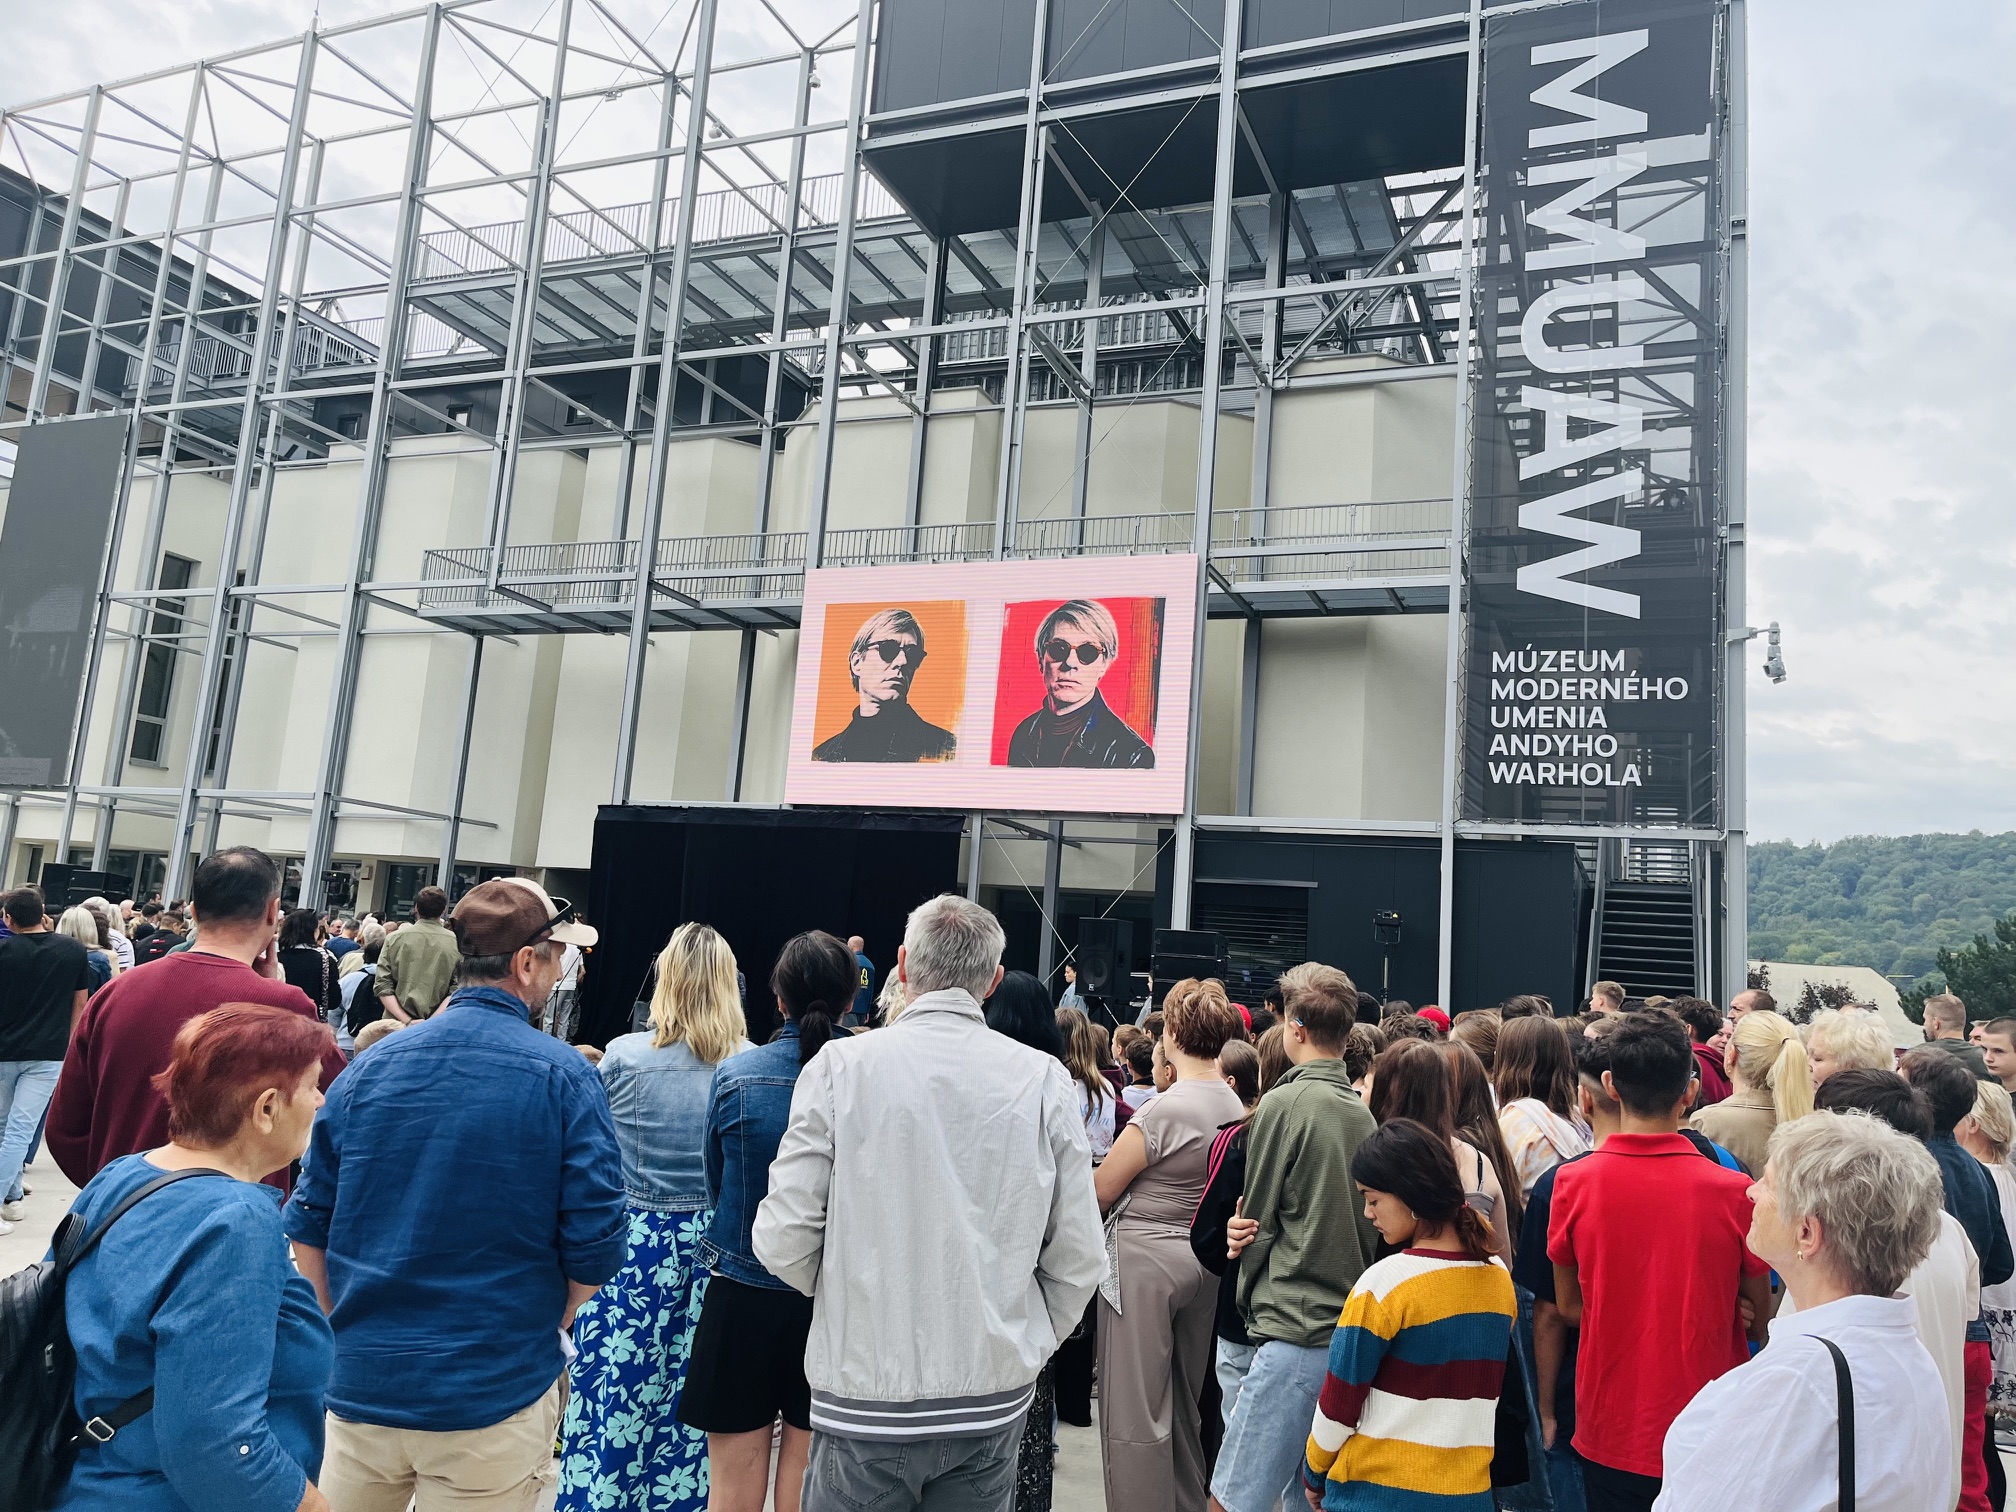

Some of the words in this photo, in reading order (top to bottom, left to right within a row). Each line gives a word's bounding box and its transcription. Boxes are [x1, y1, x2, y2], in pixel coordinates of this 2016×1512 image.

[1516, 28, 1649, 620] MMUAW
[1492, 643, 1625, 673] MÚZEUM
[1491, 670, 1689, 700] MODERNÉHO
[1490, 706, 1608, 729] UMENIA
[1489, 734, 1618, 758] ANDYHO
[1488, 762, 1642, 787] WARHOLA
